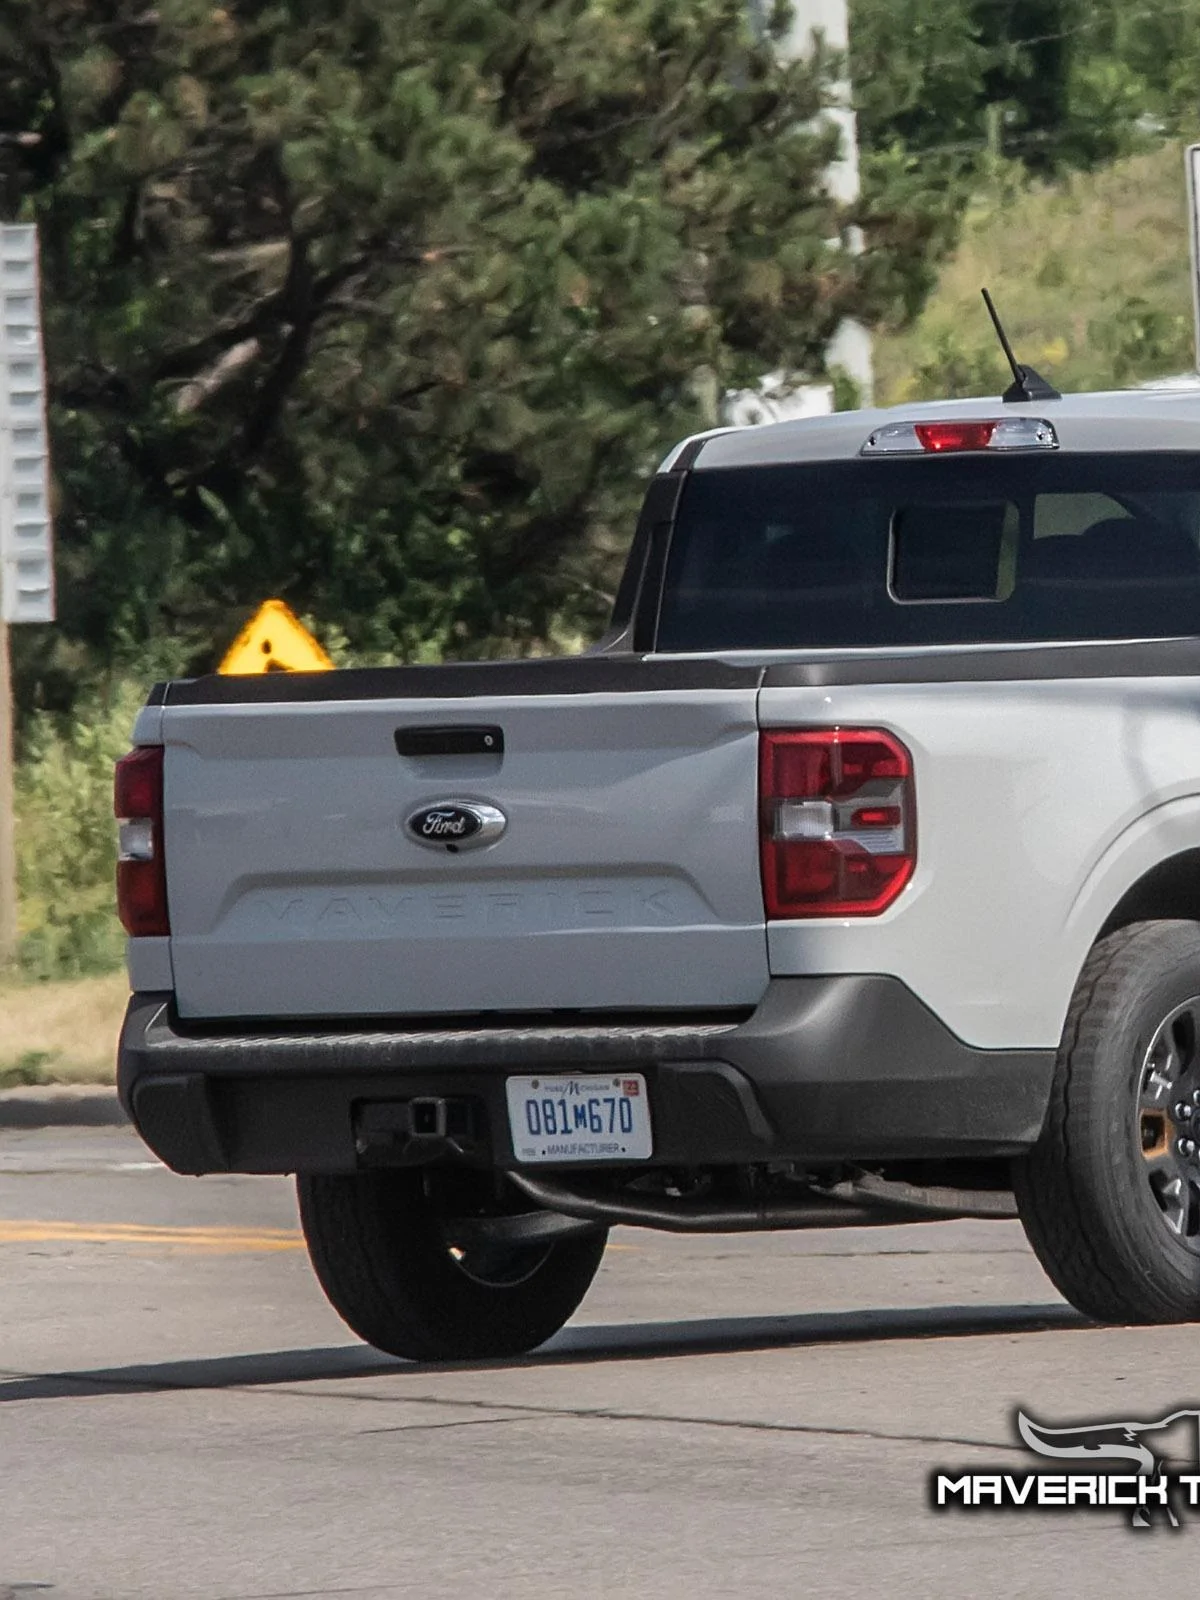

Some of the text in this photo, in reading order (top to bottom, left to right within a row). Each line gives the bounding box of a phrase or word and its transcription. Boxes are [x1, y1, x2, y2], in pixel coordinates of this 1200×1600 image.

[422, 811, 466, 834] Ford
[252, 889, 676, 926] MAVERICK
[547, 1142, 619, 1155] MANUFACTURER
